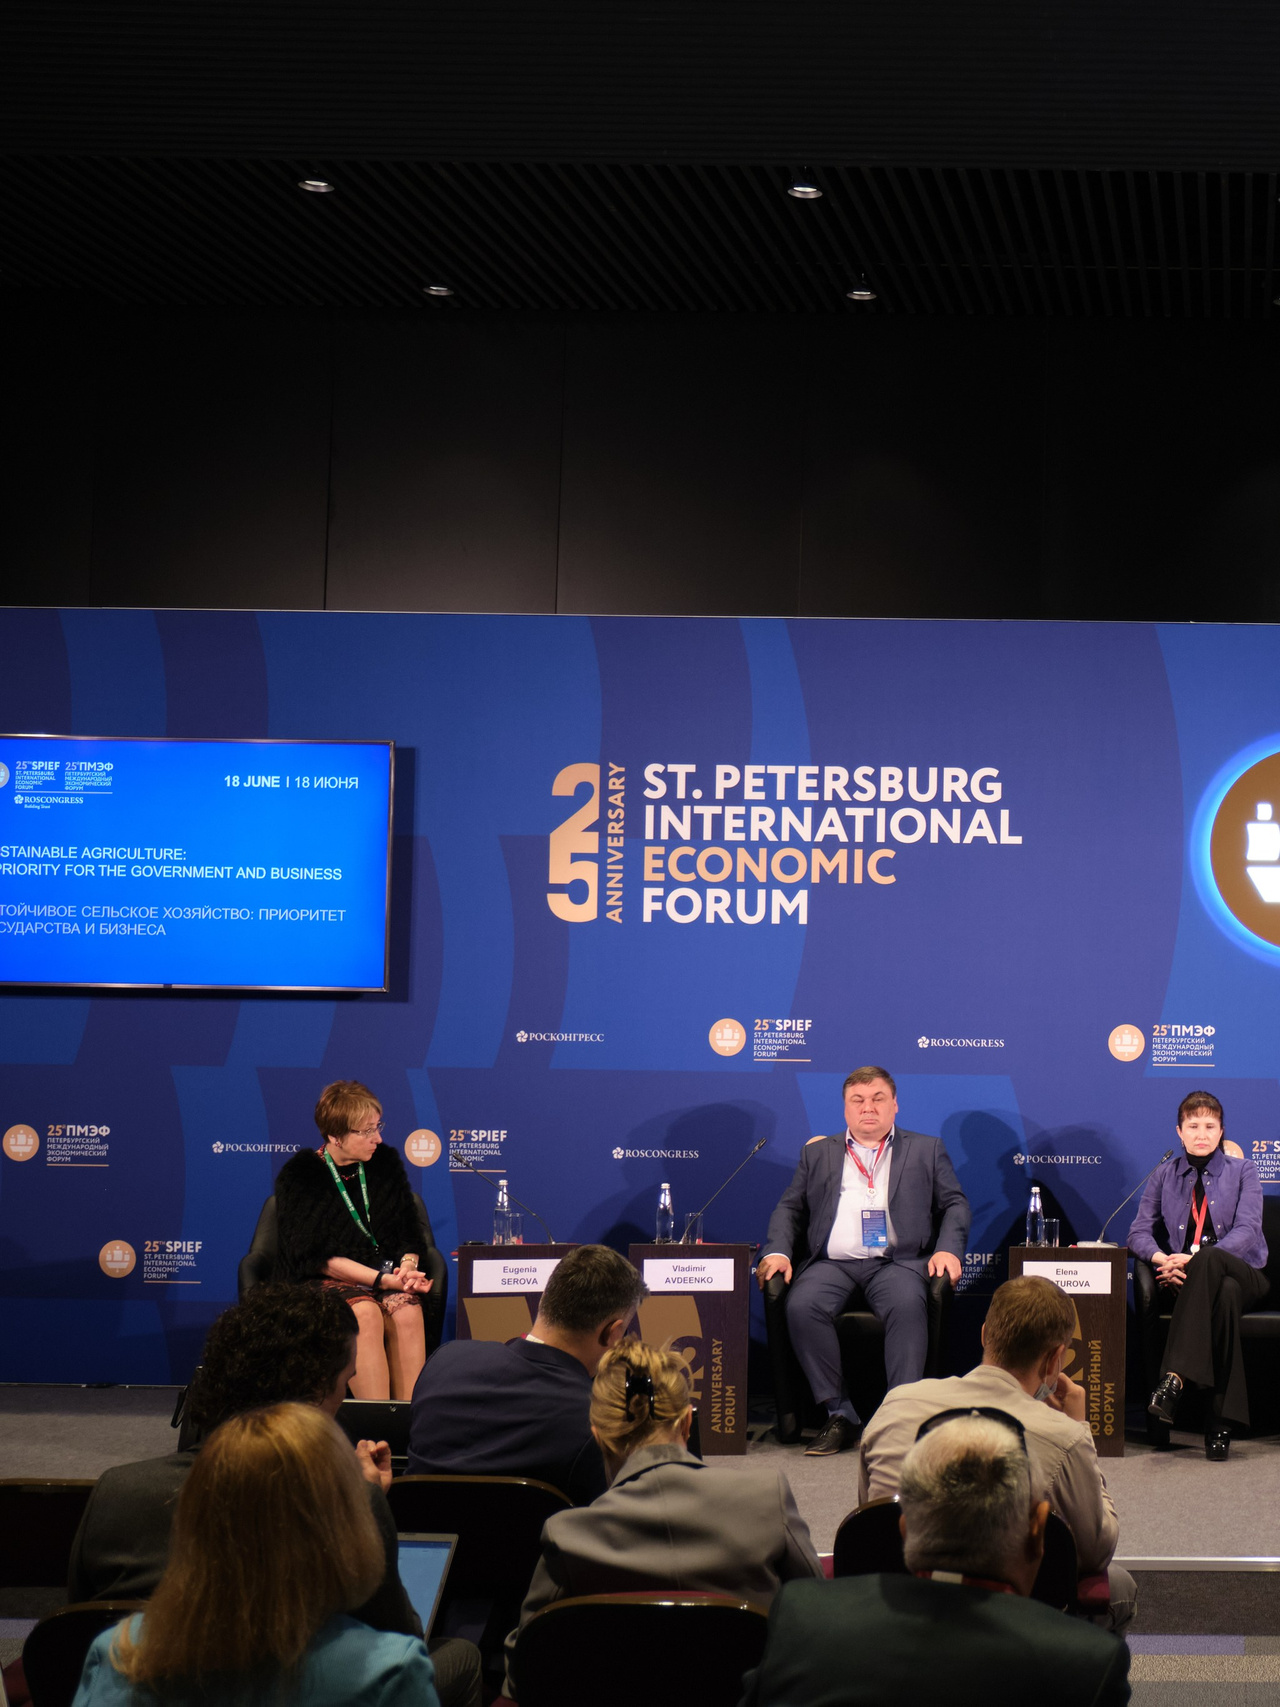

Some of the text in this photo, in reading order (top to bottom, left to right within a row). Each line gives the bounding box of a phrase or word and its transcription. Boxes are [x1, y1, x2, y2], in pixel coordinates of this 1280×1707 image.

[224, 776, 280, 788] 18 JUNE
[294, 776, 358, 789] 18 ИЮНЯ
[643, 763, 1003, 803] ST. PETERSBURG
[24, 796, 83, 804] ROSCONGRESS
[644, 805, 1022, 845] INTERNATIONAL
[606, 762, 625, 924] ANNIVERSARY
[81, 847, 186, 860] AGRICULTURE:
[643, 845, 897, 885] ECONOMIC
[64, 864, 95, 876] FOR
[99, 864, 126, 877] THE
[131, 865, 233, 878] GOVERNMENT
[236, 867, 266, 879] AND
[271, 868, 342, 880] BUSINESS
[643, 887, 808, 925] FORUM
[82, 906, 158, 918] СЕЛЬСКОЕ
[163, 906, 254, 920] ХОЗЯЙСТВО:
[260, 908, 346, 921] ПРИОРИТЕТ
[85, 923, 95, 934] И
[100, 923, 166, 936] БИЗНЕСА
[529, 1033, 604, 1042] РОСКОНГРЕСС
[931, 1038, 1005, 1047] ROSCONGRESS
[225, 1144, 300, 1152] РОСКОНГРЕСС
[626, 1149, 699, 1159] ROSCONGRESS
[1026, 1155, 1102, 1164] РОСКОНГРЕСС
[503, 1266, 537, 1275] Eugenia
[501, 1277, 538, 1286] SEROVA
[664, 1276, 713, 1284] AVDEENKO
[711, 1338, 722, 1433] ANNIVERSARY
[1088, 1340, 1101, 1436] ЮБИЛЕЙНЫЙ
[725, 1385, 736, 1434] FORUM
[1104, 1382, 1115, 1436] ФОРУМ
